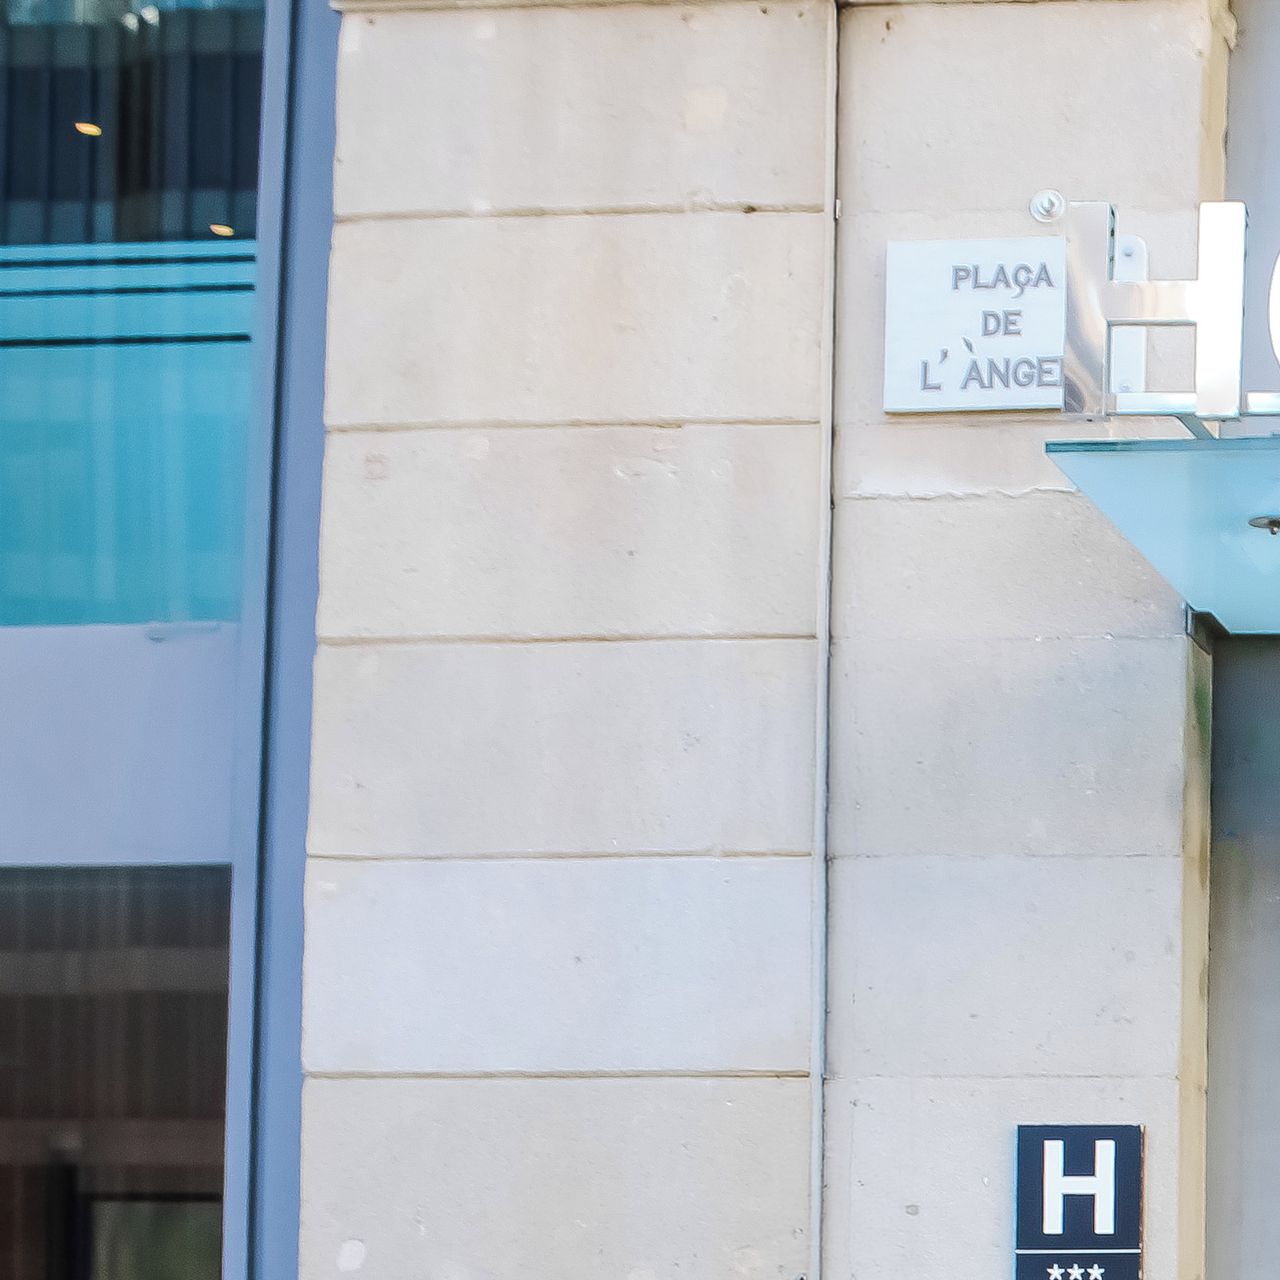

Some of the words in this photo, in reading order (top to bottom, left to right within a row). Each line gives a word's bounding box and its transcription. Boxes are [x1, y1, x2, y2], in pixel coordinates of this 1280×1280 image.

[951, 263, 1055, 299] PLAÇA
[981, 309, 1023, 337] DE
[920, 337, 1064, 390] L'ÀNGE
[1042, 1139, 1116, 1235] H
